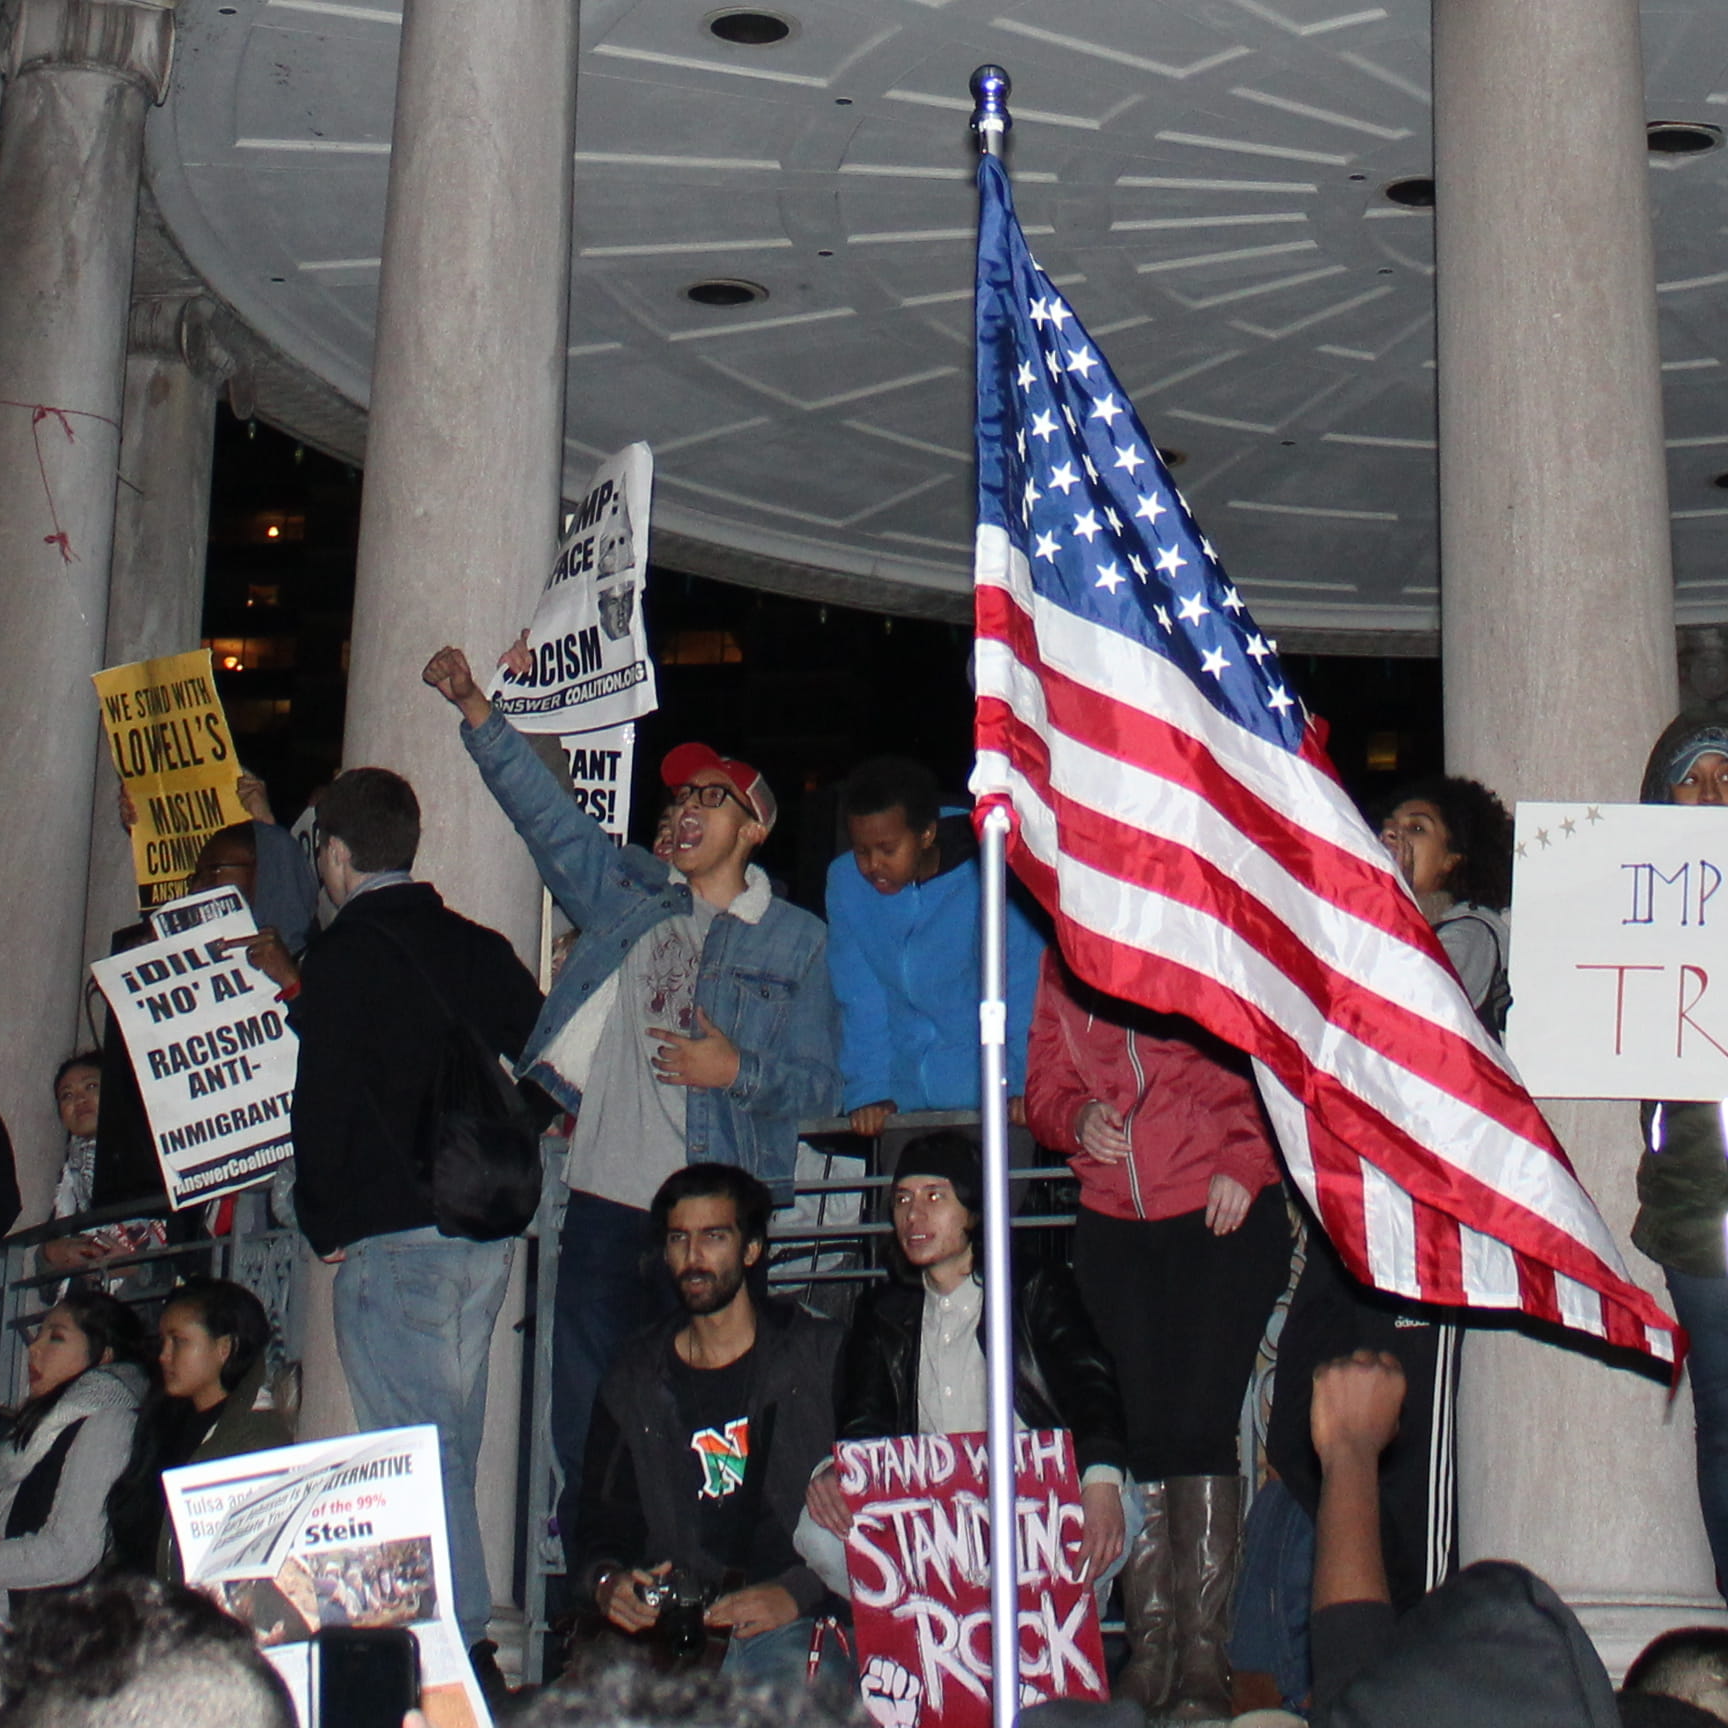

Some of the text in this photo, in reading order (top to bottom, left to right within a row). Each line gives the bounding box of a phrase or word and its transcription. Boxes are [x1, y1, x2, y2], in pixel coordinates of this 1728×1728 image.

[105, 676, 212, 723] WE STND WITH
[210, 968, 254, 1003] AL
[148, 1010, 285, 1080] RACISMO
[188, 1055, 262, 1099] ANTI-
[159, 1089, 296, 1155] INMIGRANT
[837, 1427, 1069, 1496] STAND WTH
[184, 1497, 223, 1518] Tulsa
[311, 1492, 387, 1518] of the 99%
[305, 1517, 374, 1547] Stein
